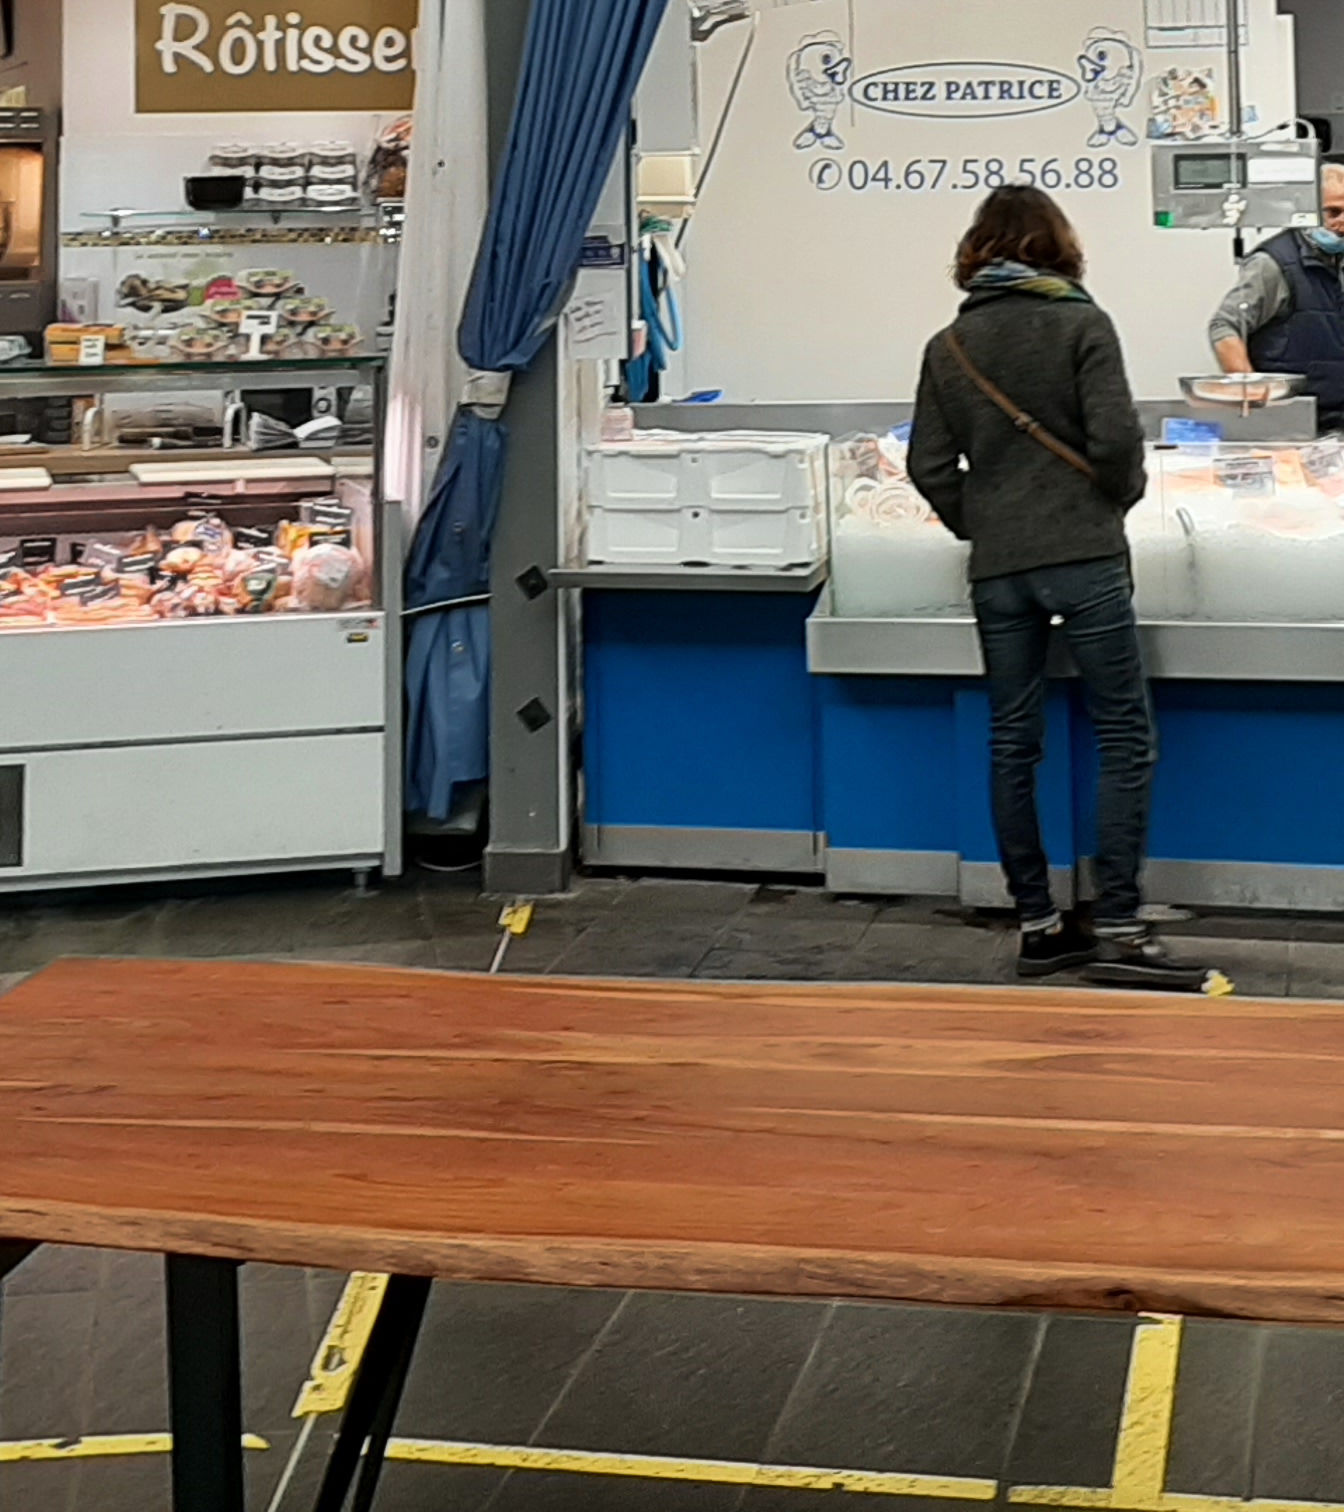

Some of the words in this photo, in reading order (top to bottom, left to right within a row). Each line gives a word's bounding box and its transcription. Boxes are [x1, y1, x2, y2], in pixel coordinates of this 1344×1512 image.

[862, 81, 937, 102] CHEZ
[944, 78, 1063, 101] PATRICE
[847, 157, 1120, 191] 04.67.5856.88
